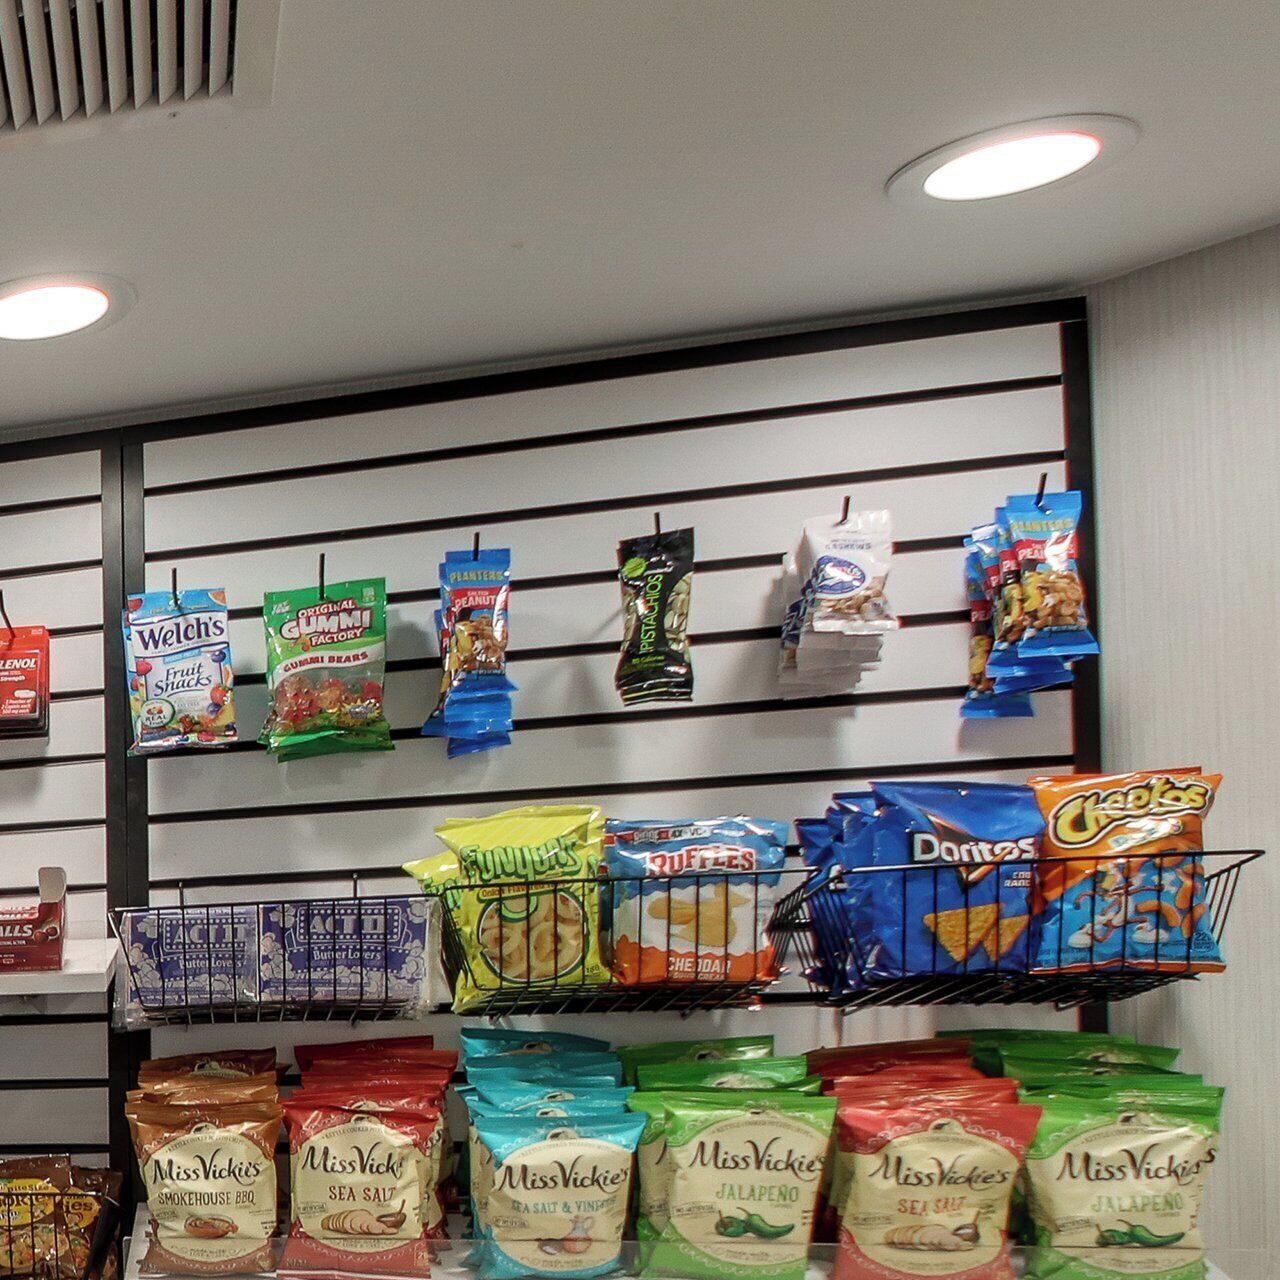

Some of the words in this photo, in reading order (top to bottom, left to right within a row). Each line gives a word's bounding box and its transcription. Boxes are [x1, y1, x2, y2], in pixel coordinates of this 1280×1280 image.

[450, 570, 503, 583] PLANTERS
[298, 599, 355, 618] ORIGINAL
[640, 571, 665, 653] PISTACHIOS
[135, 616, 225, 651] Welch's
[281, 610, 371, 639] GUMMI
[312, 628, 362, 646] FACTORY
[166, 662, 204, 682] Fruit
[283, 656, 324, 672] GUMMI
[328, 651, 368, 664] BEARS
[0, 674, 26, 682] Strength
[154, 674, 212, 698] Snacks
[1049, 776, 1212, 849] Cheetos
[913, 832, 1037, 864] Doritos
[460, 839, 583, 884] FUNYUNS
[648, 846, 757, 875] RUFFLES
[309, 915, 355, 934] ACT
[312, 949, 345, 961] Butter
[302, 1143, 346, 1174] Miss
[689, 1143, 753, 1172] Miss
[746, 1136, 828, 1175] Vickie's
[1056, 1149, 1128, 1182] Miss
[153, 1159, 200, 1183] Miss
[195, 1148, 263, 1186] Vickie's
[498, 1165, 559, 1192] Miss
[554, 1155, 629, 1189] Vickie's
[868, 1152, 933, 1187] Miss
[935, 1154, 1010, 1190] Vickie's
[157, 1190, 232, 1206] SMOKEHOUSE
[235, 1190, 255, 1205] BBQ
[329, 1186, 359, 1201] SEA
[363, 1186, 397, 1201] SALT
[716, 1183, 800, 1202] JALAPEÑO
[1092, 1192, 1184, 1213] JALAPEÑO
[536, 1201, 559, 1214] SALT
[562, 1203, 572, 1214] &
[898, 1198, 928, 1216] SEA
[932, 1196, 965, 1215] SALT
